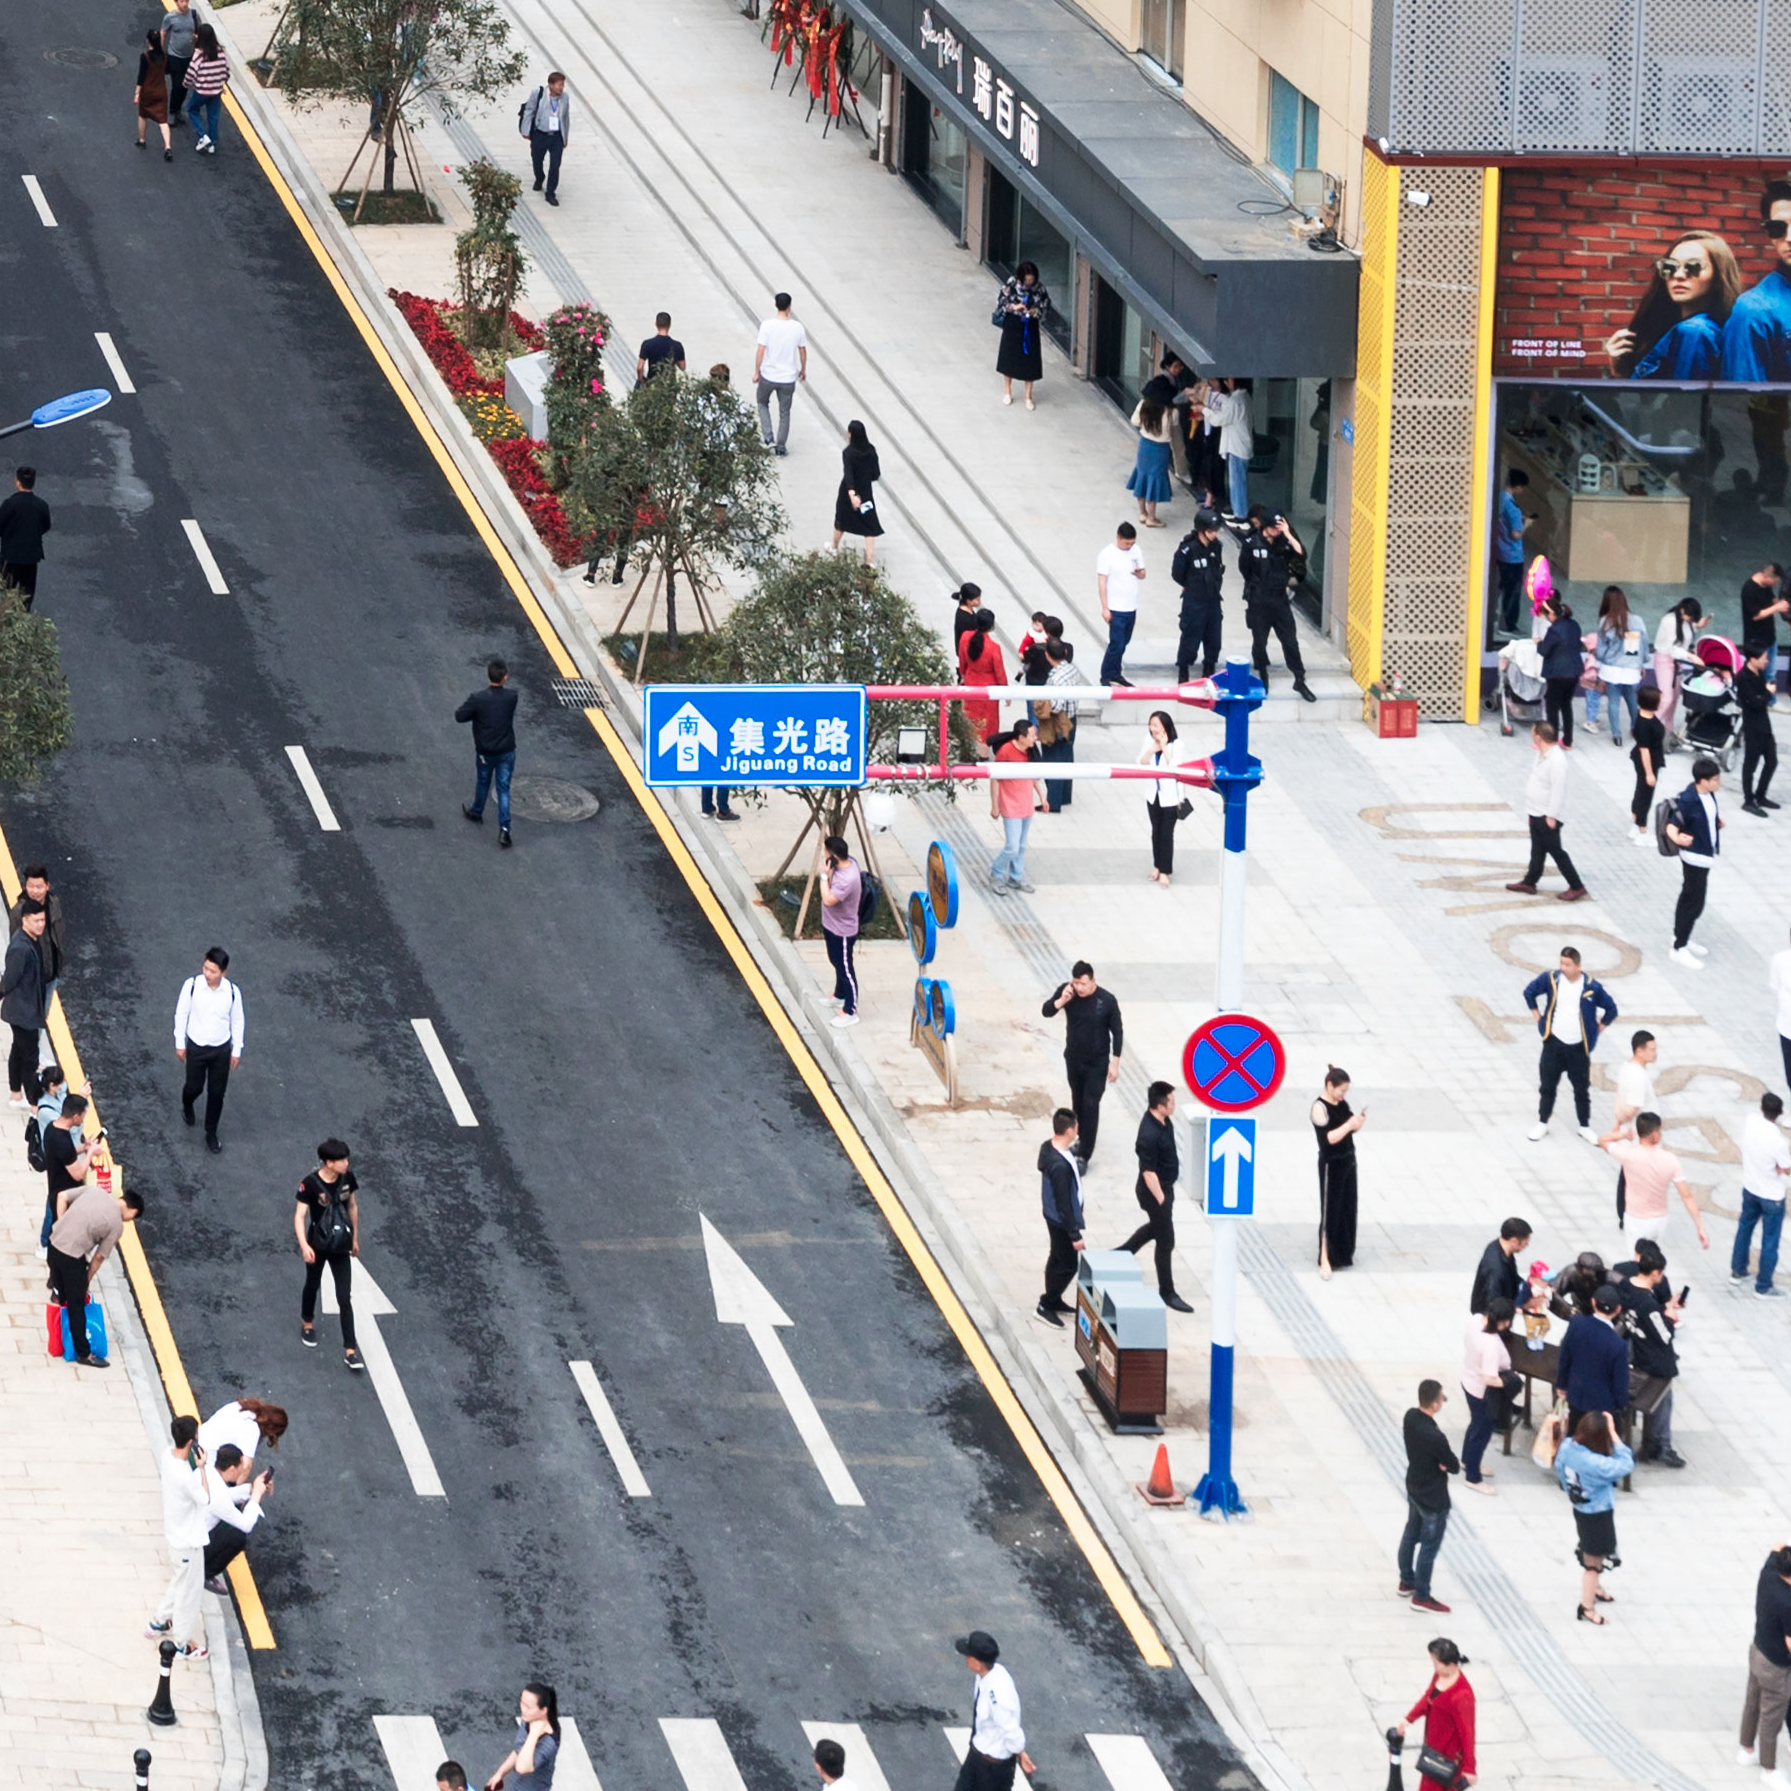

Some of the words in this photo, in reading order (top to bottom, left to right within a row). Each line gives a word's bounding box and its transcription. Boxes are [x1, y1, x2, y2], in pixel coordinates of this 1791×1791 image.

[972, 56, 1040, 168] 瑞百丽
[1545, 340, 1558, 348] OF
[1545, 349, 1558, 357] OF
[677, 715, 700, 737] 南
[729, 717, 850, 755] 集光路
[683, 746, 695, 761] S
[720, 756, 798, 774] Jiguang
[803, 756, 851, 772] Road
